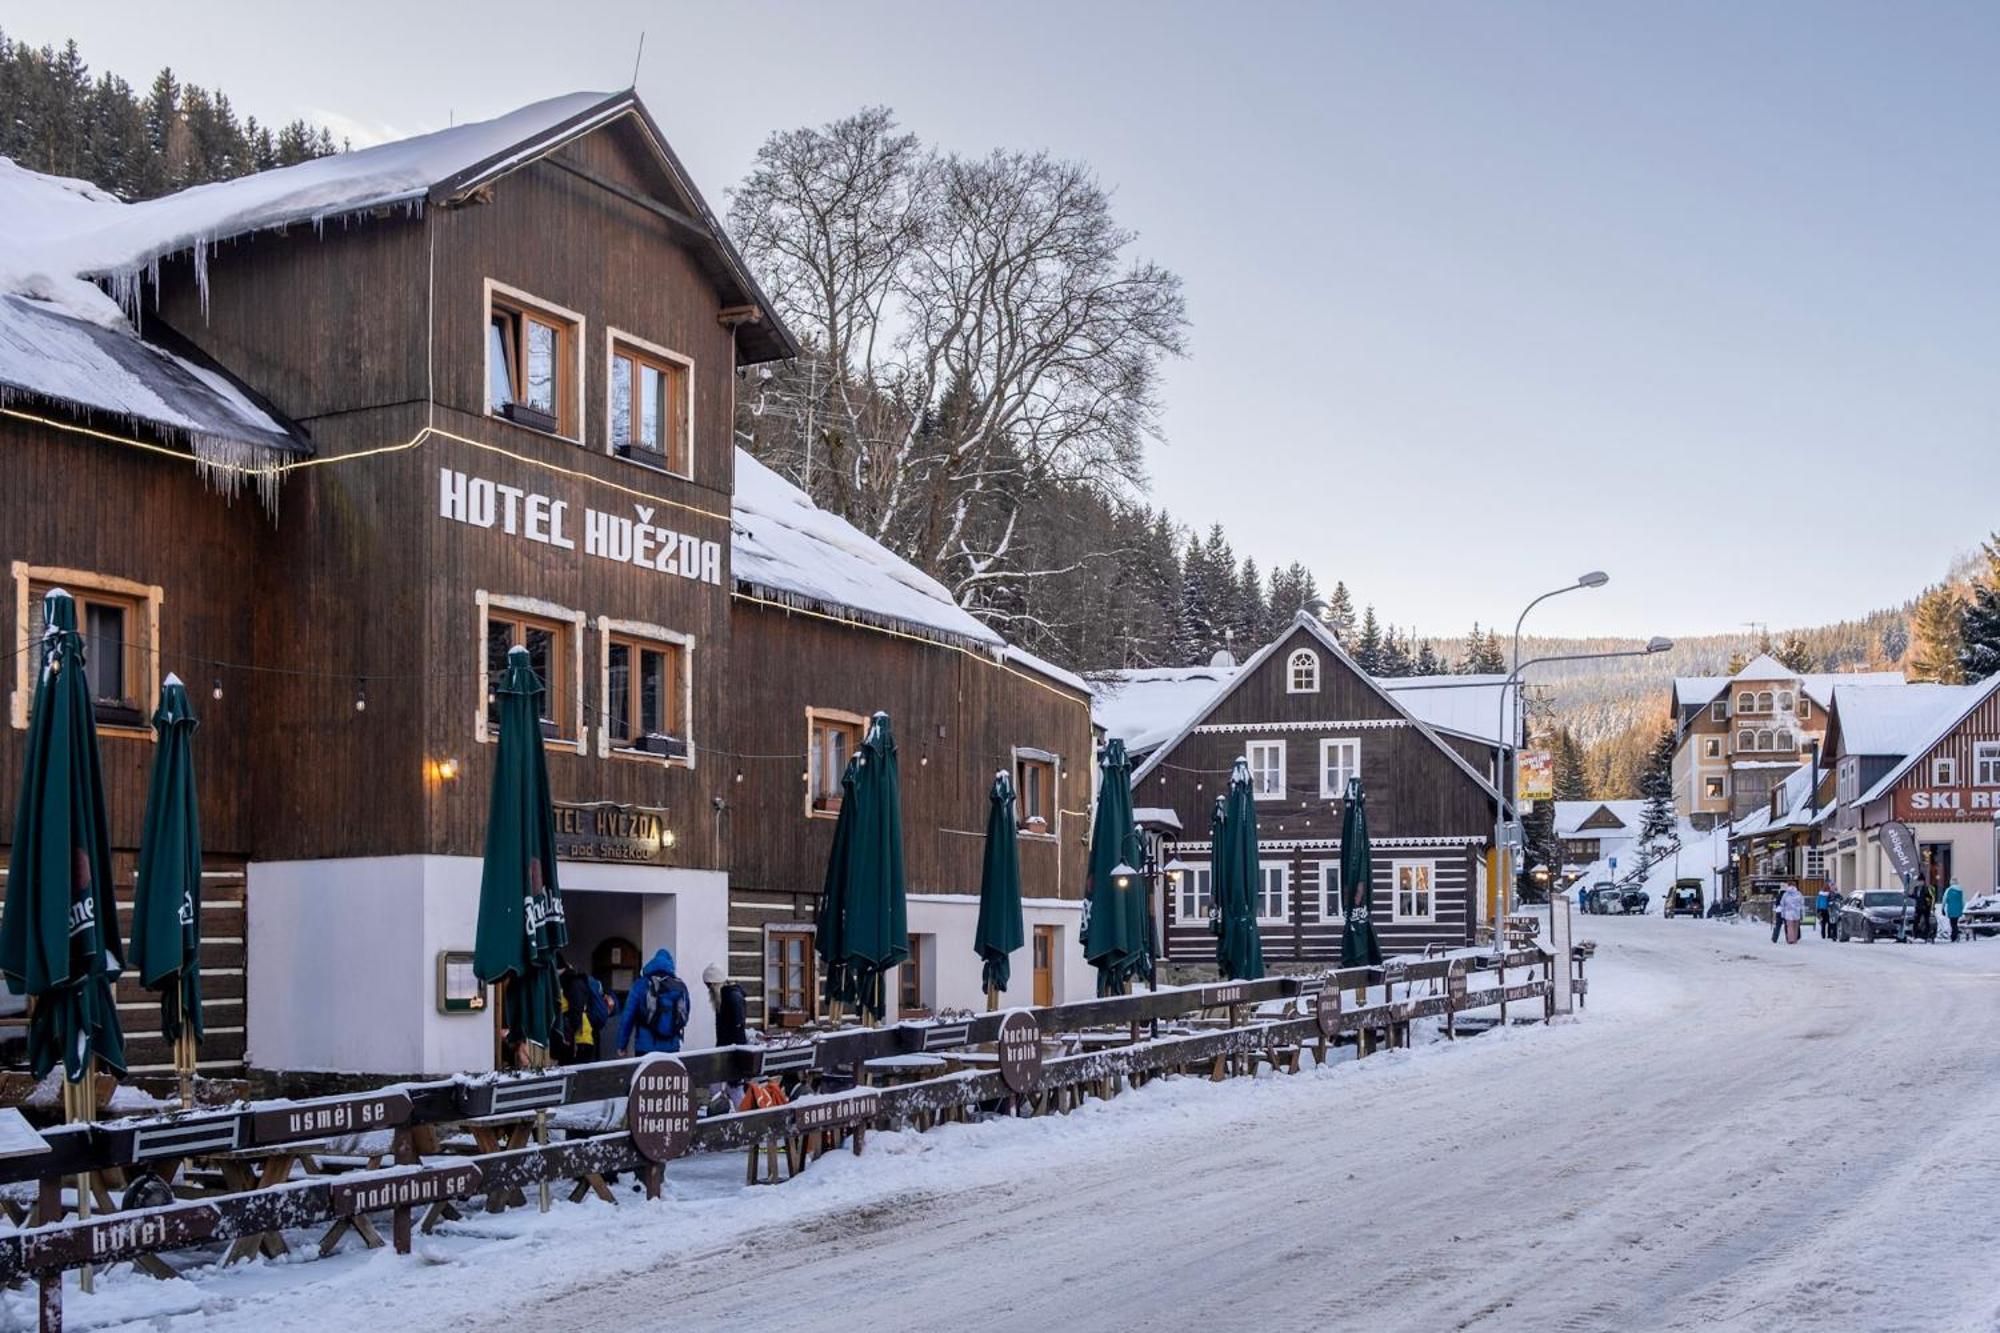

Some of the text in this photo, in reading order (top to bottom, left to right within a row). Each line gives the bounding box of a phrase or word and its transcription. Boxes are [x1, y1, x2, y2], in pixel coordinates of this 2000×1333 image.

[440, 467, 575, 550] HOTEL
[1911, 791, 1960, 809] SKI
[362, 1103, 385, 1123] se
[446, 1176, 466, 1195] se
